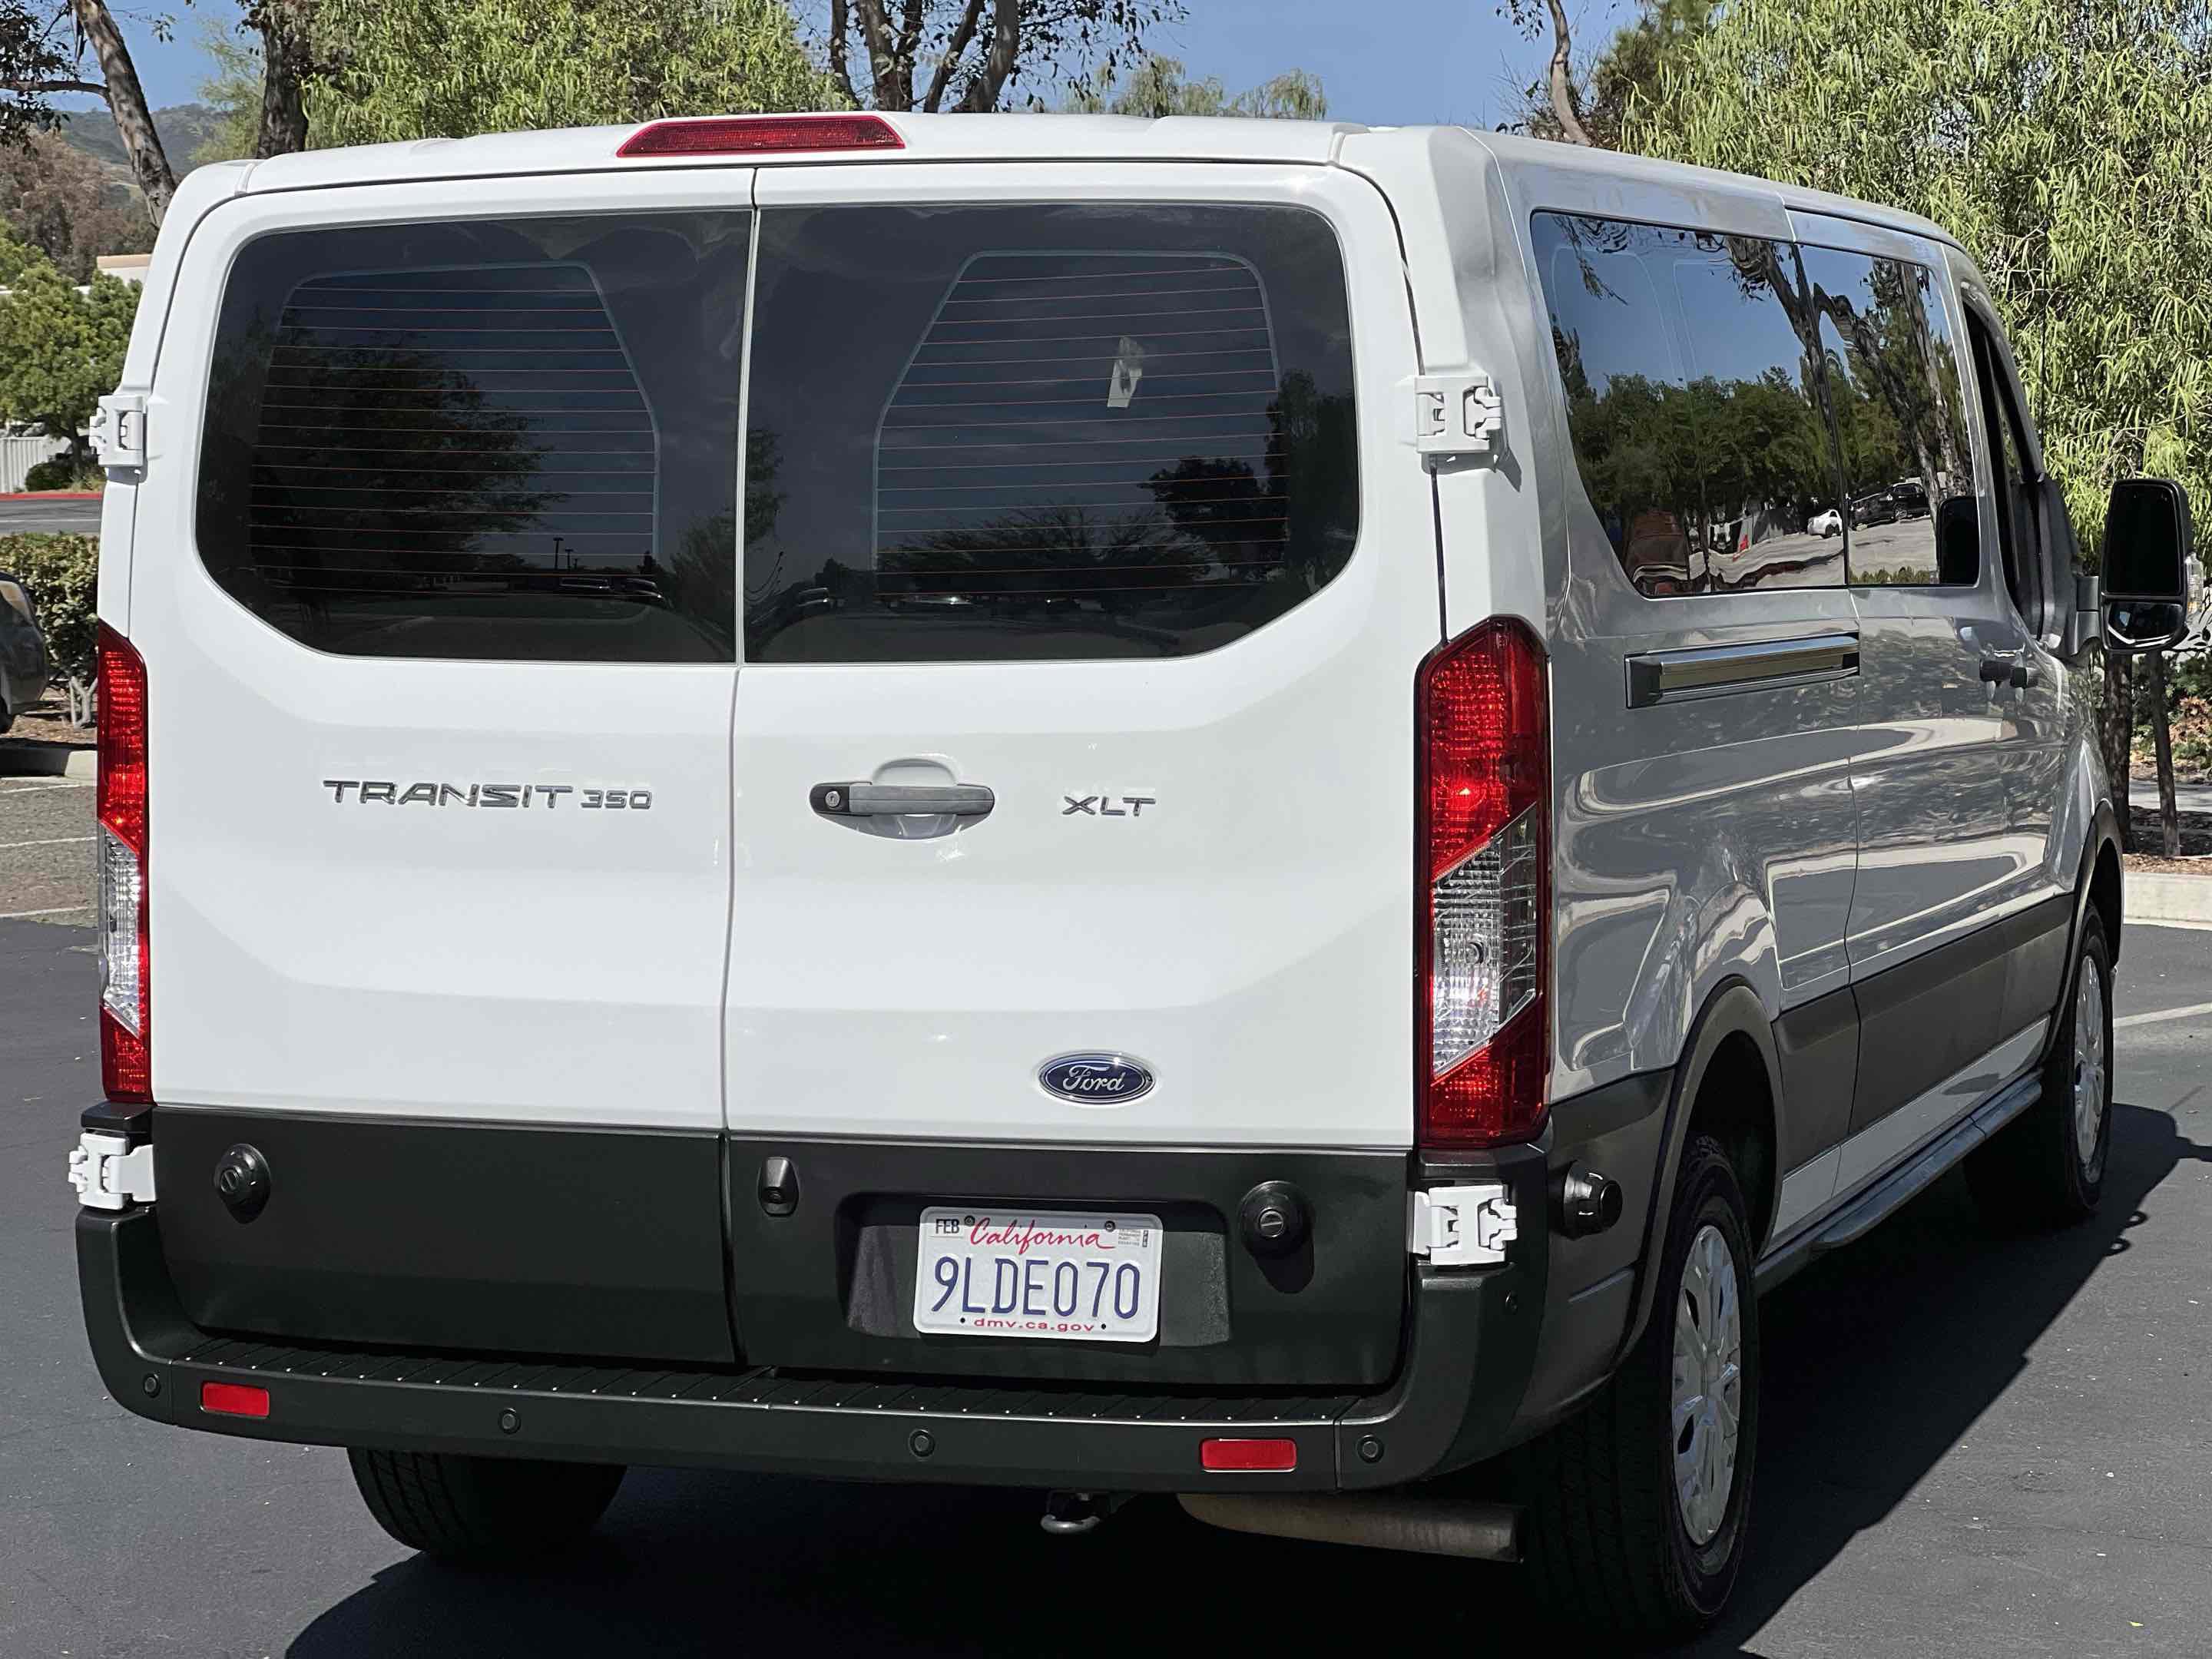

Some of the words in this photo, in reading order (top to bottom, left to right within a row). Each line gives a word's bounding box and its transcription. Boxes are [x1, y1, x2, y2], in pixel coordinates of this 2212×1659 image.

[323, 780, 574, 809] TRANSIT
[581, 789, 652, 810] 350
[1062, 796, 1157, 817] XLT
[1062, 1065, 1126, 1091] Ford
[935, 1218, 960, 1234] FEB
[970, 1217, 1116, 1255] California
[931, 1256, 1141, 1320] 9LDE070
[973, 1317, 1094, 1333] dmv.ca.gov
